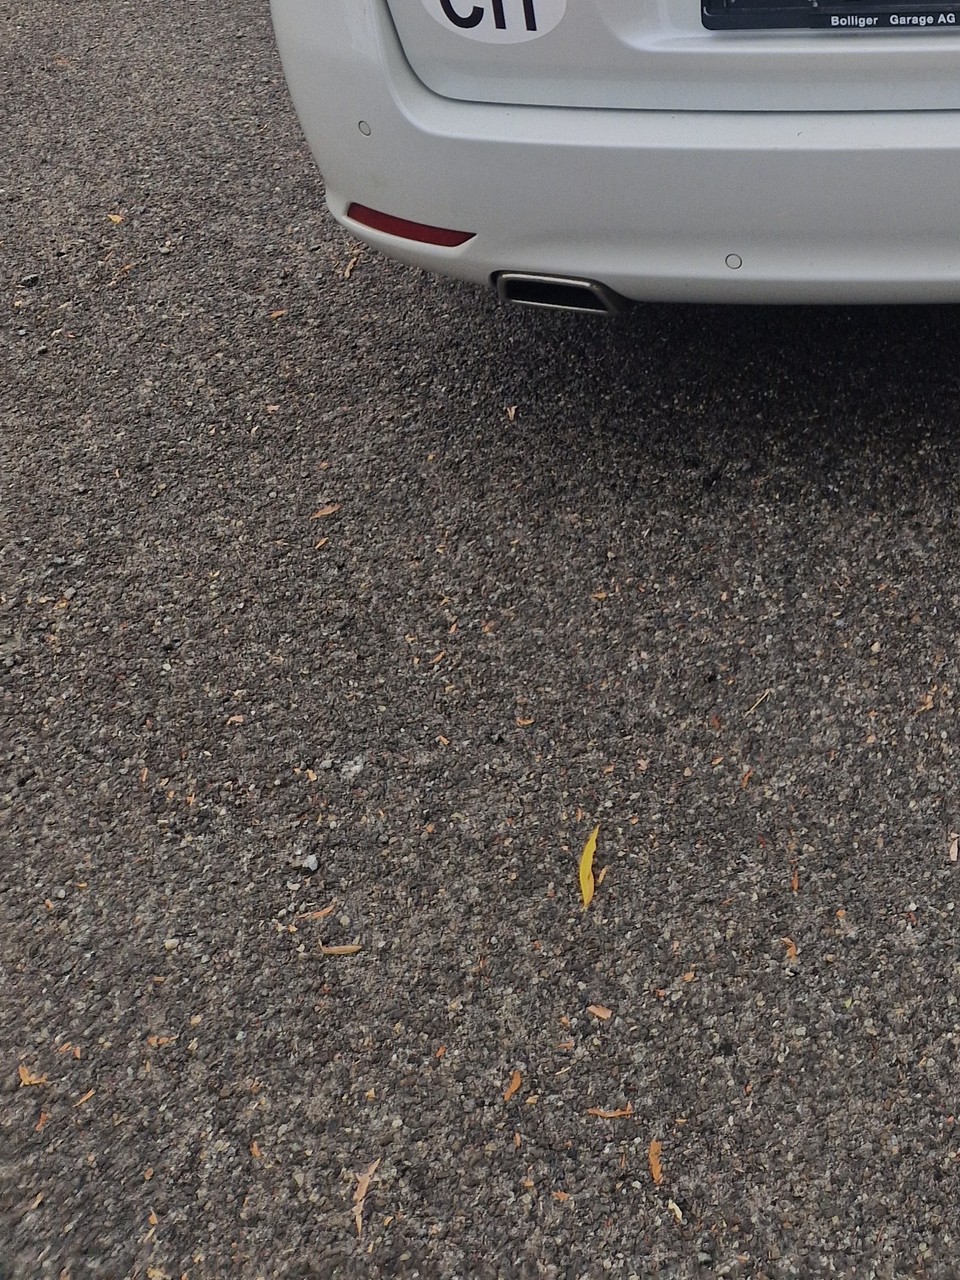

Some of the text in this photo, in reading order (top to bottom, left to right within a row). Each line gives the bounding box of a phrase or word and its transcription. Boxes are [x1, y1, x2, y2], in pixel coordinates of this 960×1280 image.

[831, 15, 878, 27] Bolliger
[889, 14, 934, 26] Garage
[937, 13, 956, 24] AG
